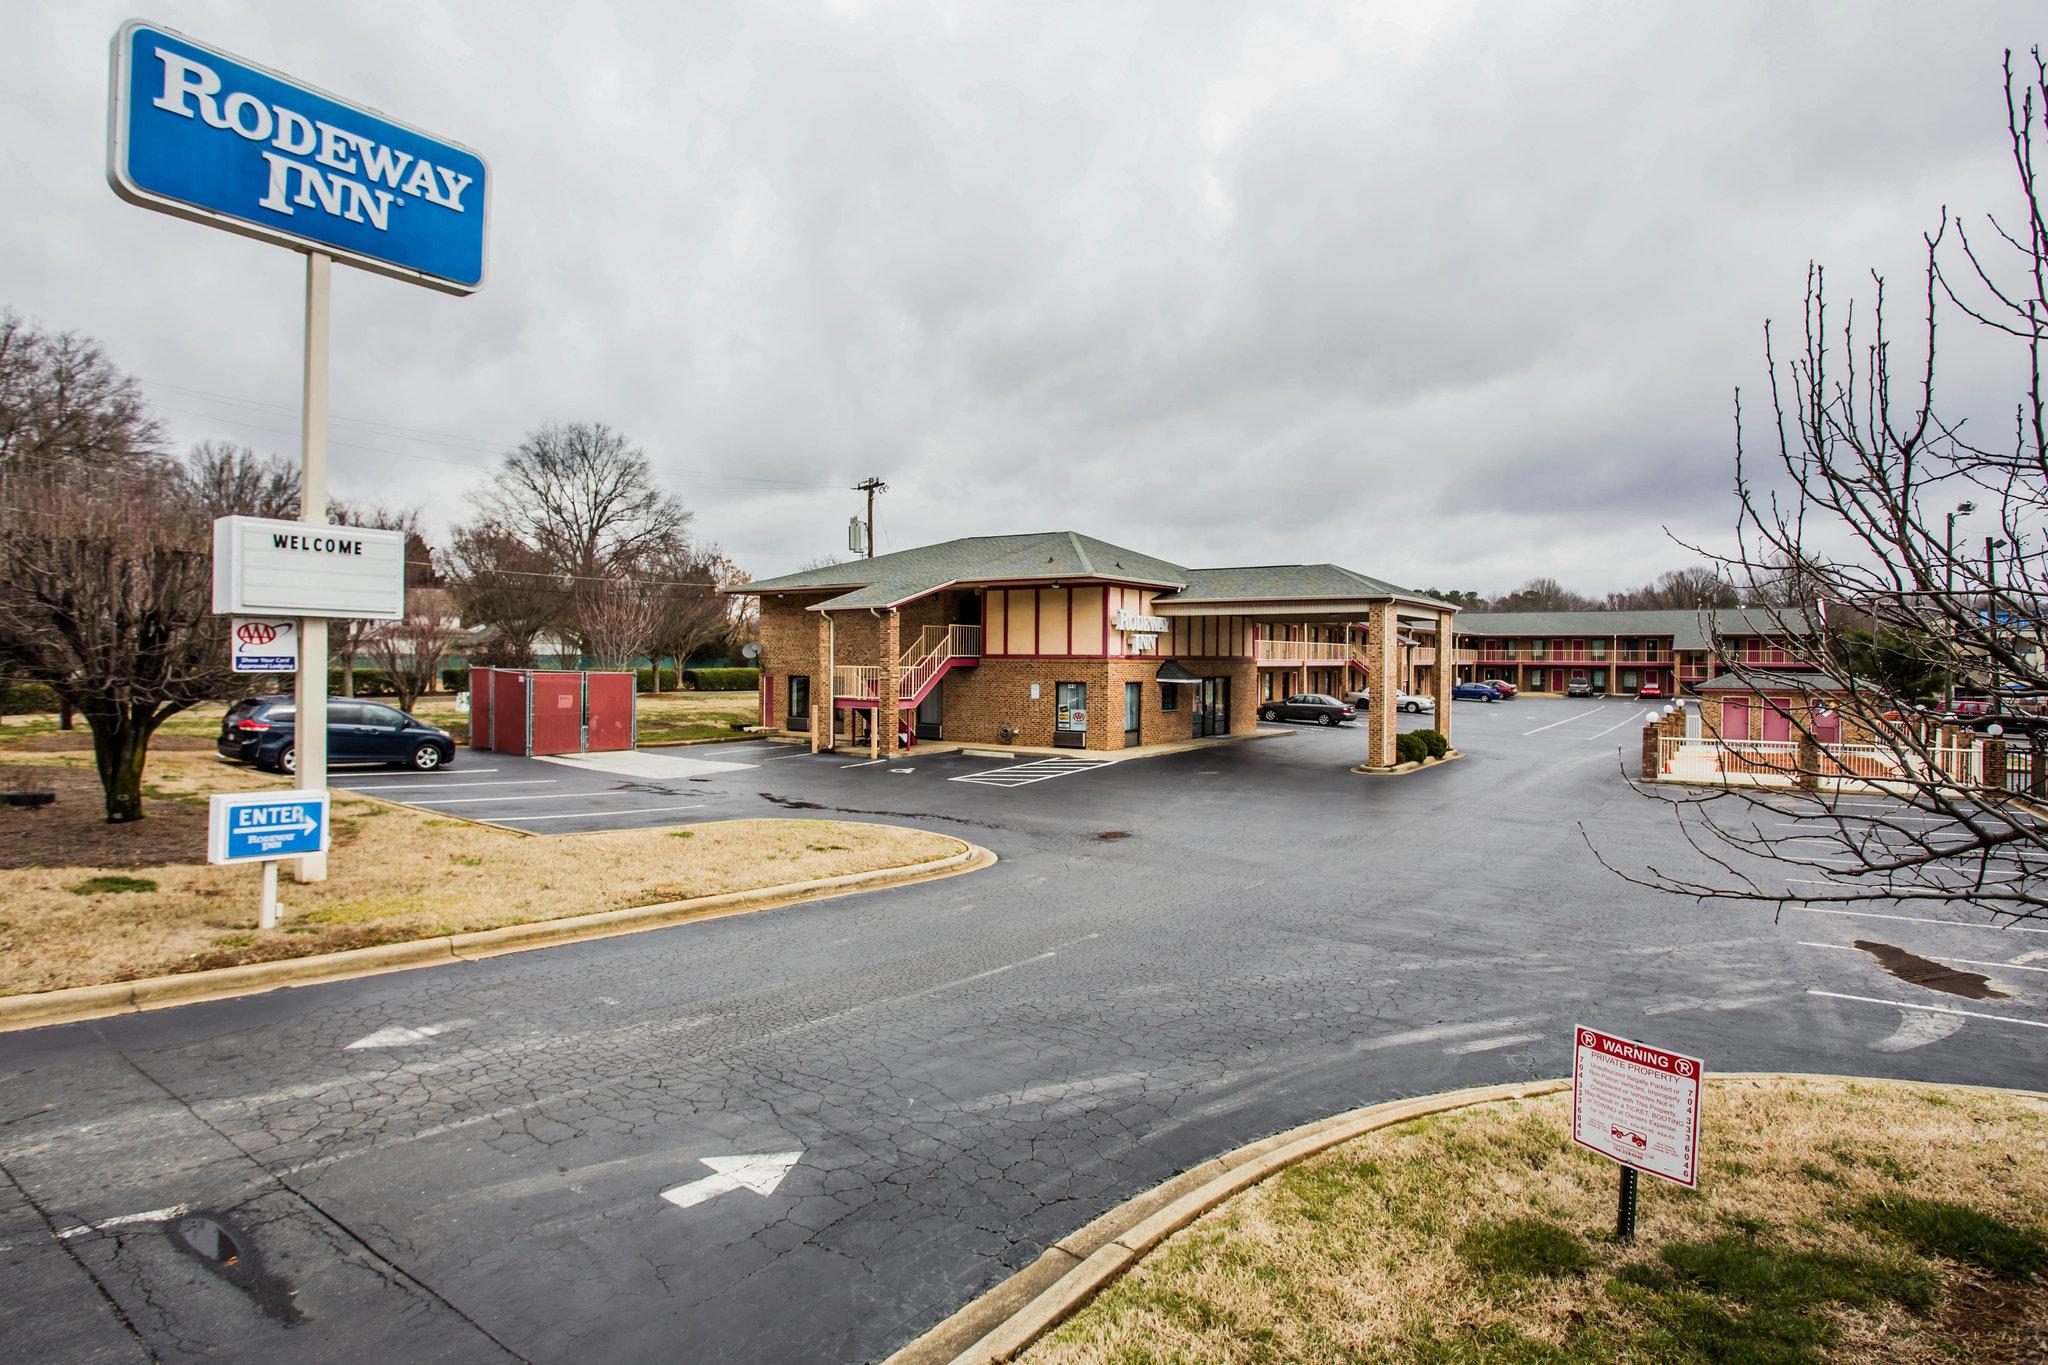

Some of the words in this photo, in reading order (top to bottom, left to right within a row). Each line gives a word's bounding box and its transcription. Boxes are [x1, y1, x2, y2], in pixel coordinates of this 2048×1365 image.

[153, 47, 473, 213] RODEWAY
[259, 150, 397, 231] INN
[273, 534, 362, 555] WELCOME
[242, 623, 272, 644] AAA
[239, 806, 304, 826] ENTER
[1602, 1038, 1668, 1068] WARNING
[1590, 1062, 1624, 1078] Unauthorized
[1649, 1081, 1672, 1092] Parked
[1591, 1051, 1624, 1068] PRIVATE
[1627, 1062, 1679, 1085] PROPERTY
[1590, 1085, 1621, 1100] Compliance
[1622, 1096, 1633, 1104] with
[1636, 1100, 1647, 1108] This
[1593, 1078, 1621, 1092] Registered
[1629, 1090, 1654, 1103] Vehicles
[1656, 1098, 1667, 1107] Not
[1593, 1100, 1615, 1112] TOWING
[1647, 1088, 1680, 1104] Improperly
[1584, 1089, 1594, 1097] May
[1651, 1111, 1683, 1127] BOOTING
